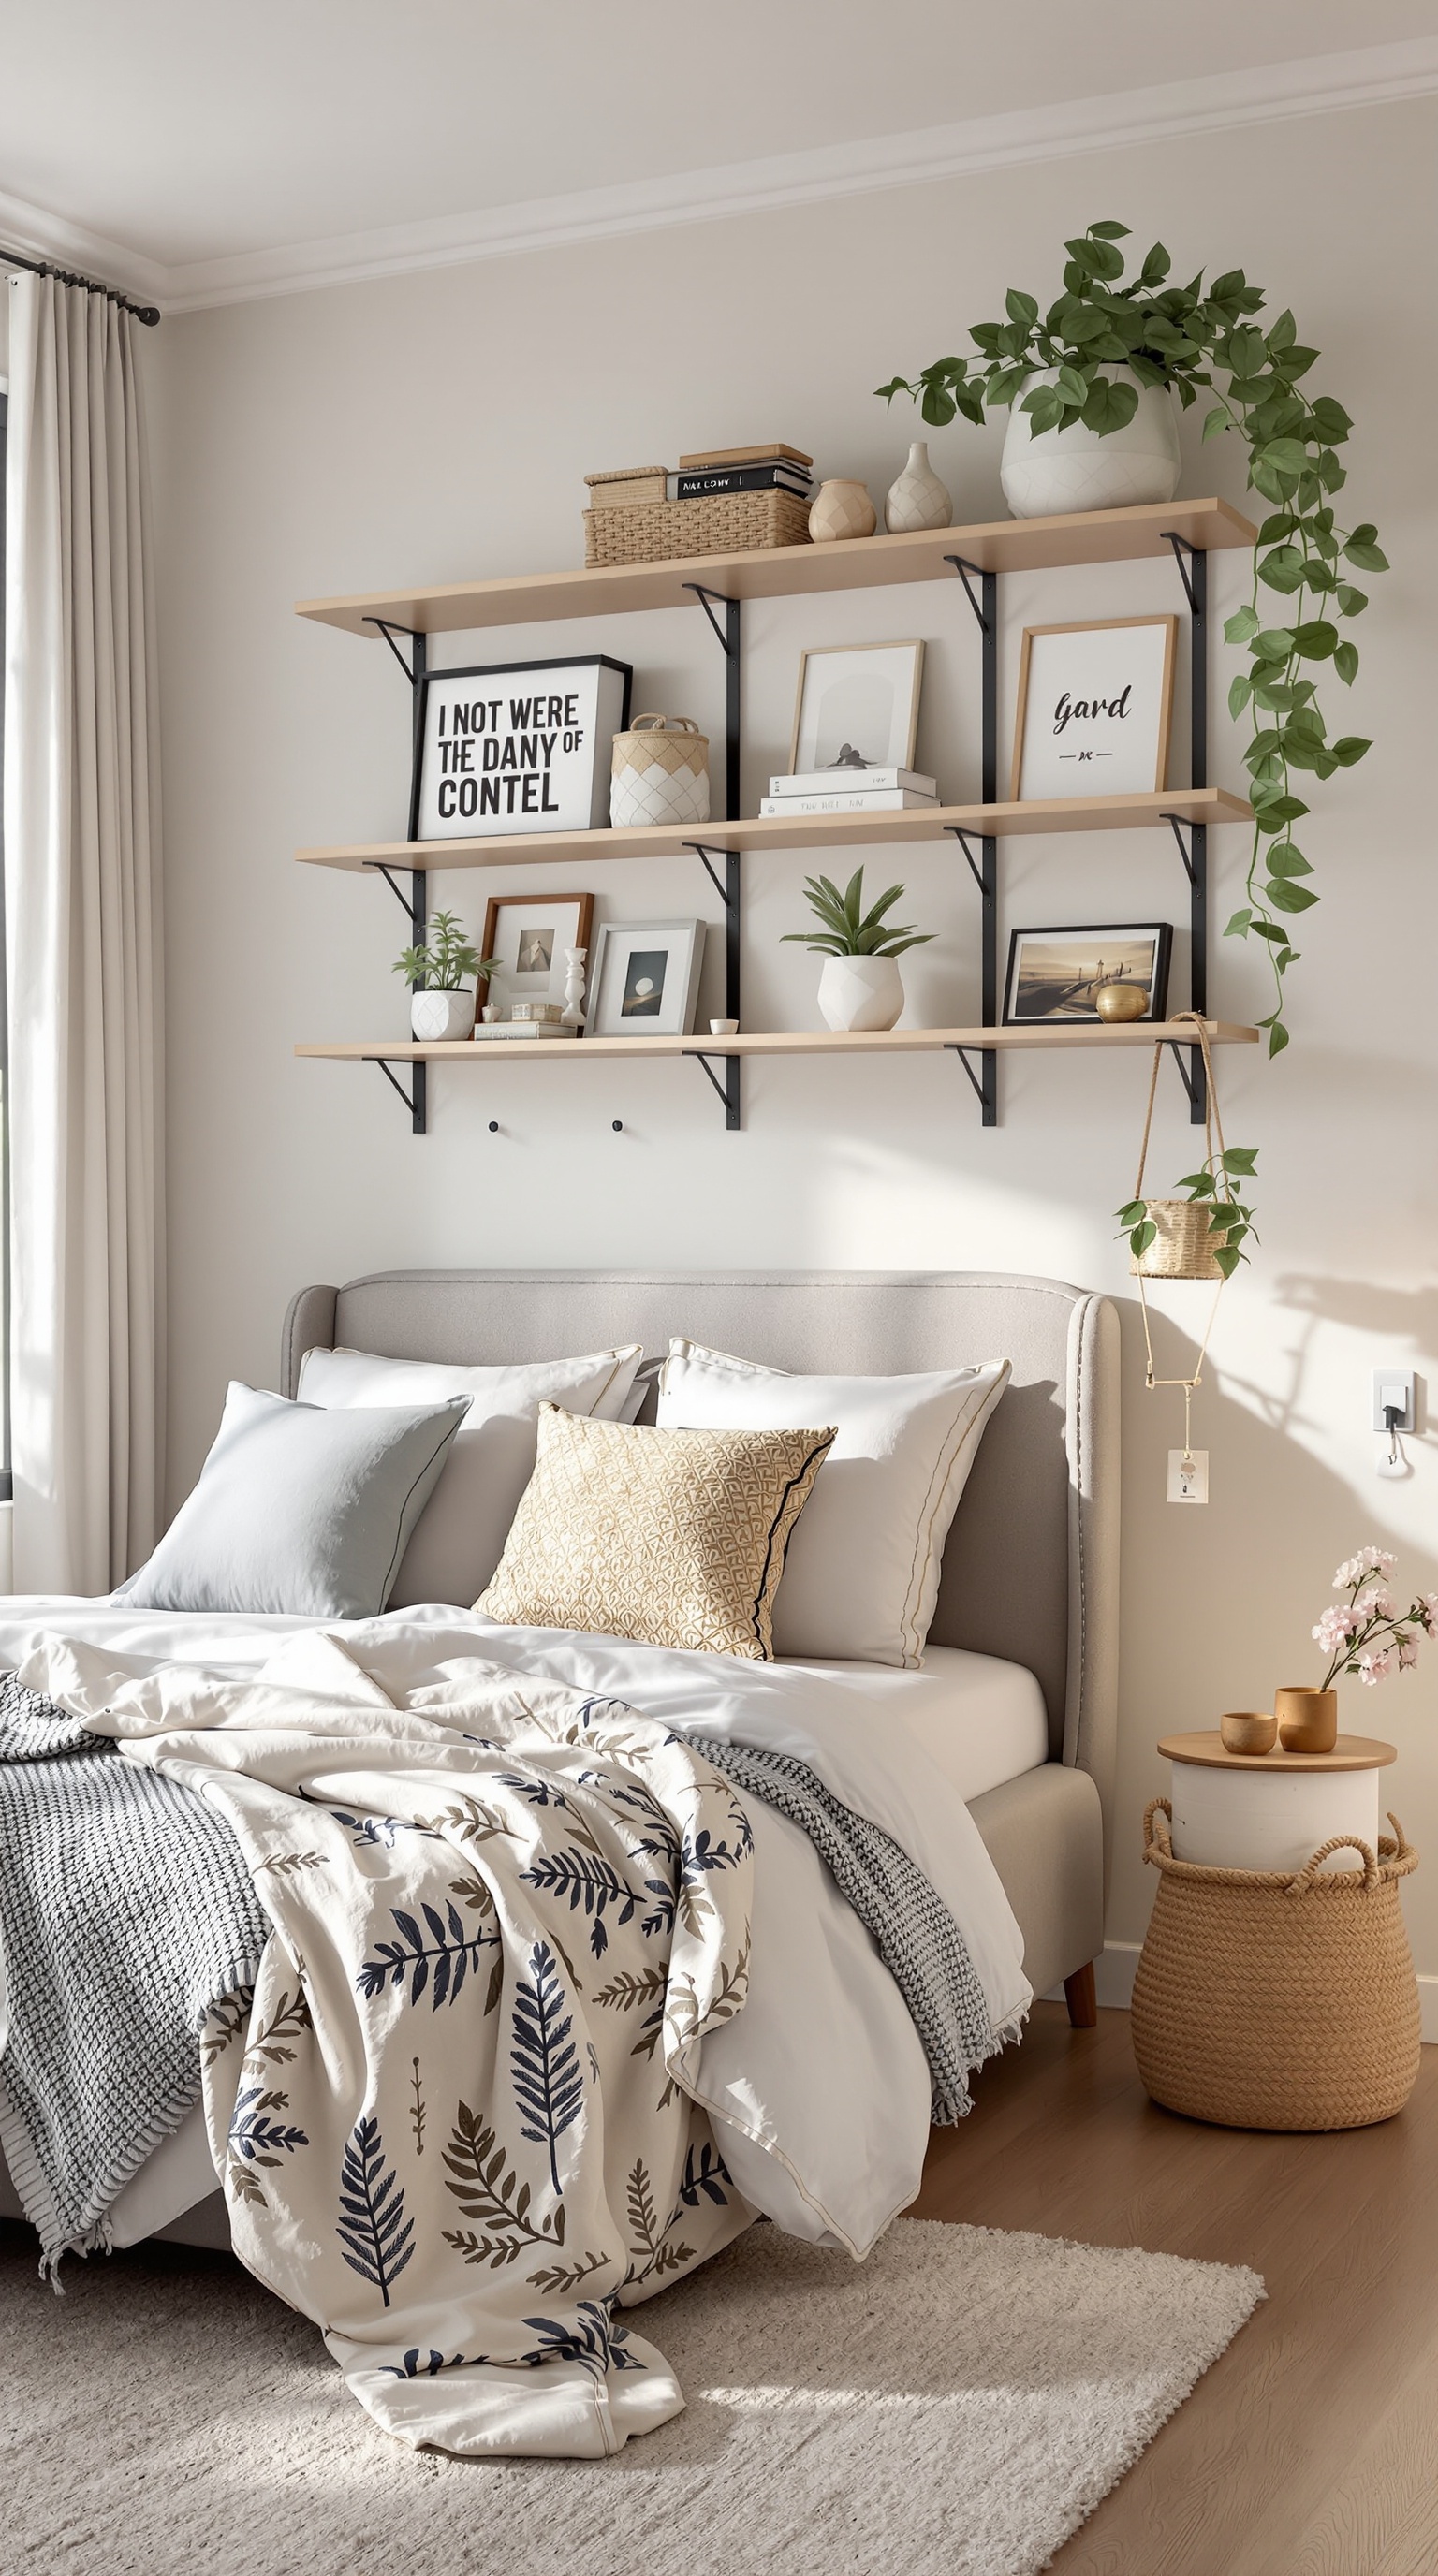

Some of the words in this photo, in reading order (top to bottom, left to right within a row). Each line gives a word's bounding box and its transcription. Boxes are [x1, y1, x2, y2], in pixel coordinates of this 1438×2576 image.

[438, 705, 446, 737] I
[452, 700, 503, 736] NOT
[509, 693, 579, 730] WERE
[482, 732, 558, 772] DANY
[563, 730, 584, 754] OF
[438, 772, 559, 819] CONTEL
